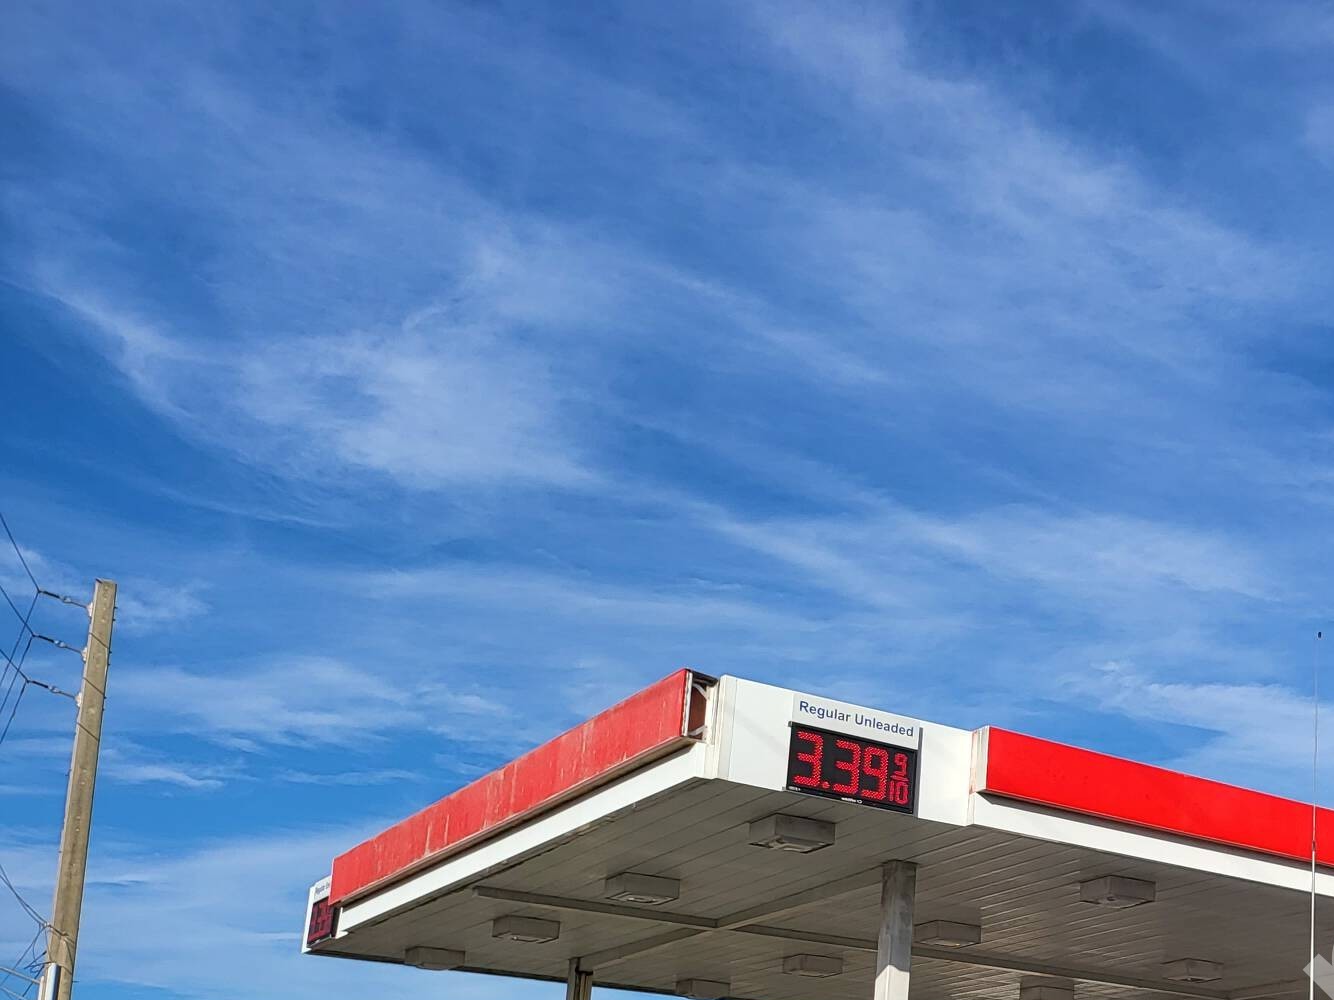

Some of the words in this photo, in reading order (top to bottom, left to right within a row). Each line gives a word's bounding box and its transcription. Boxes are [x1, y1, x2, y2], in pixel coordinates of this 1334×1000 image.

[799, 700, 851, 722] Regular
[855, 713, 914, 737] Unleaded
[793, 730, 889, 801] 3.39
